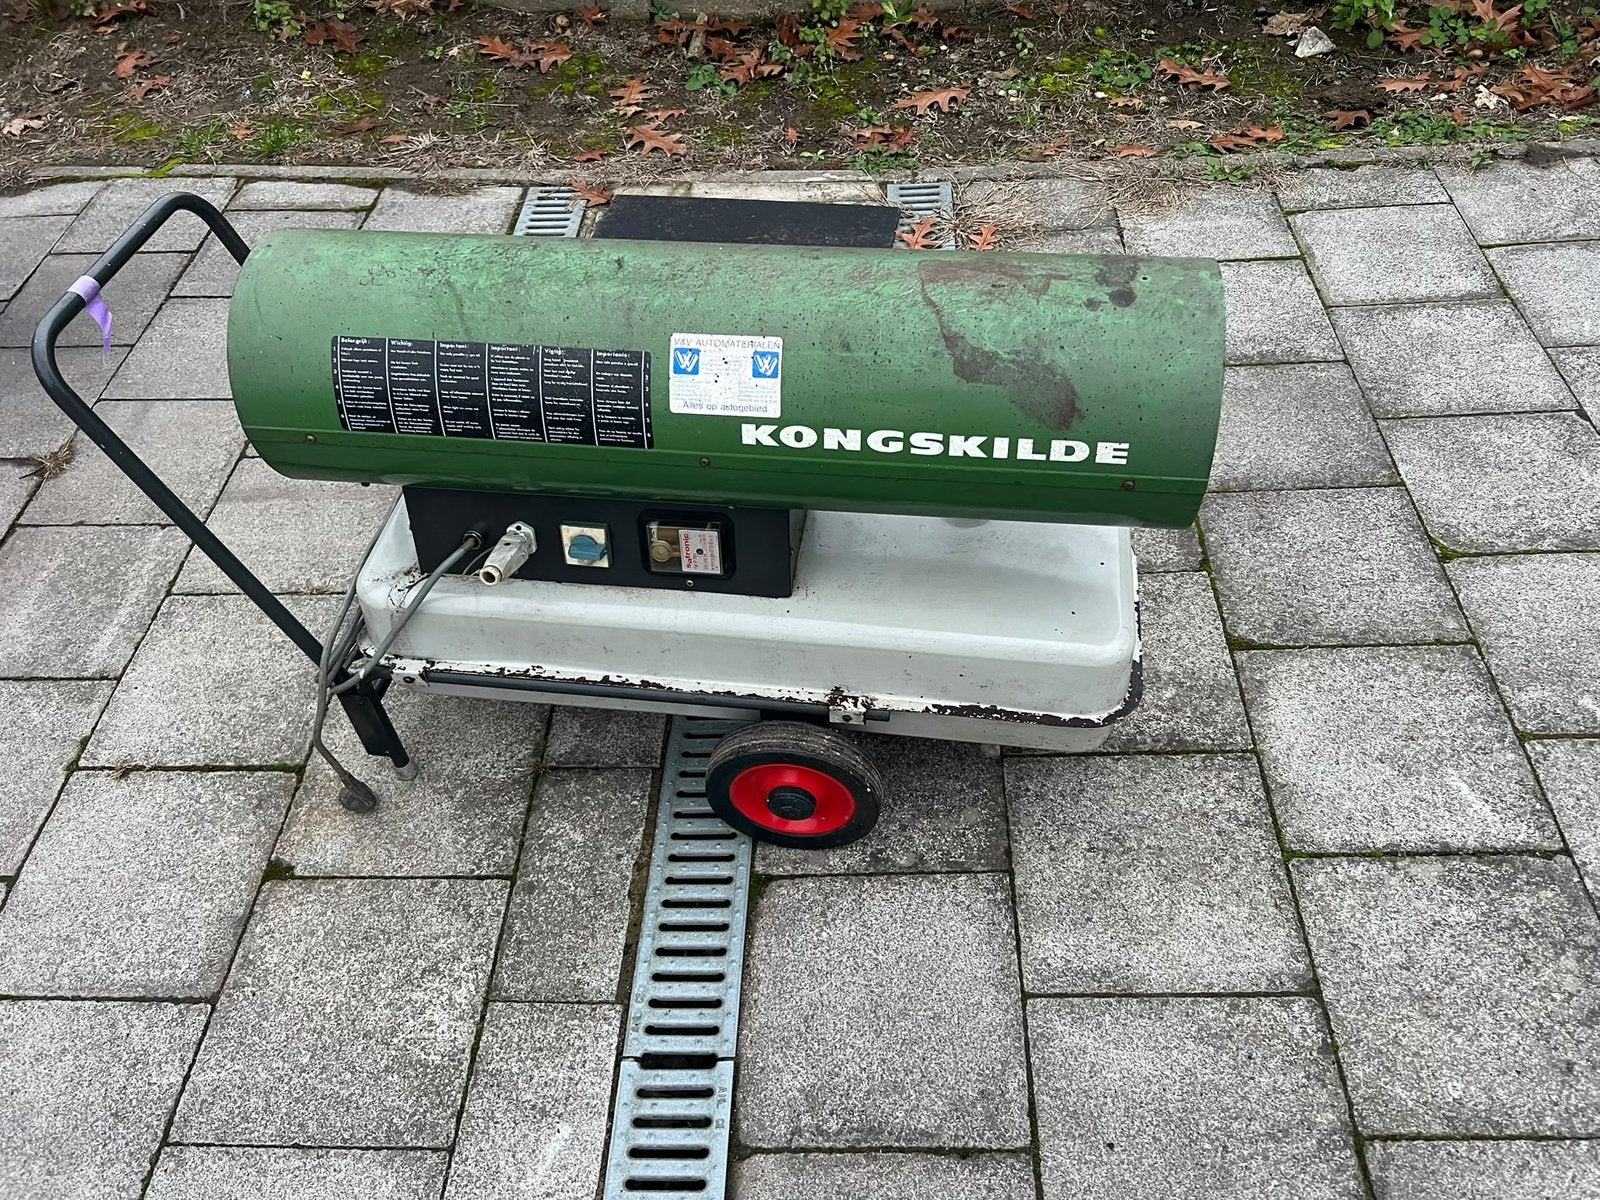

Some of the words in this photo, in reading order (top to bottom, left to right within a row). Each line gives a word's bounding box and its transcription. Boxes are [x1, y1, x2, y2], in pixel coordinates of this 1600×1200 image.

[695, 338, 780, 349] AUTOMATERIALEN
[683, 401, 704, 410] Alles
[720, 403, 768, 413] autogebied
[740, 423, 1130, 465] KONGSKILDE
